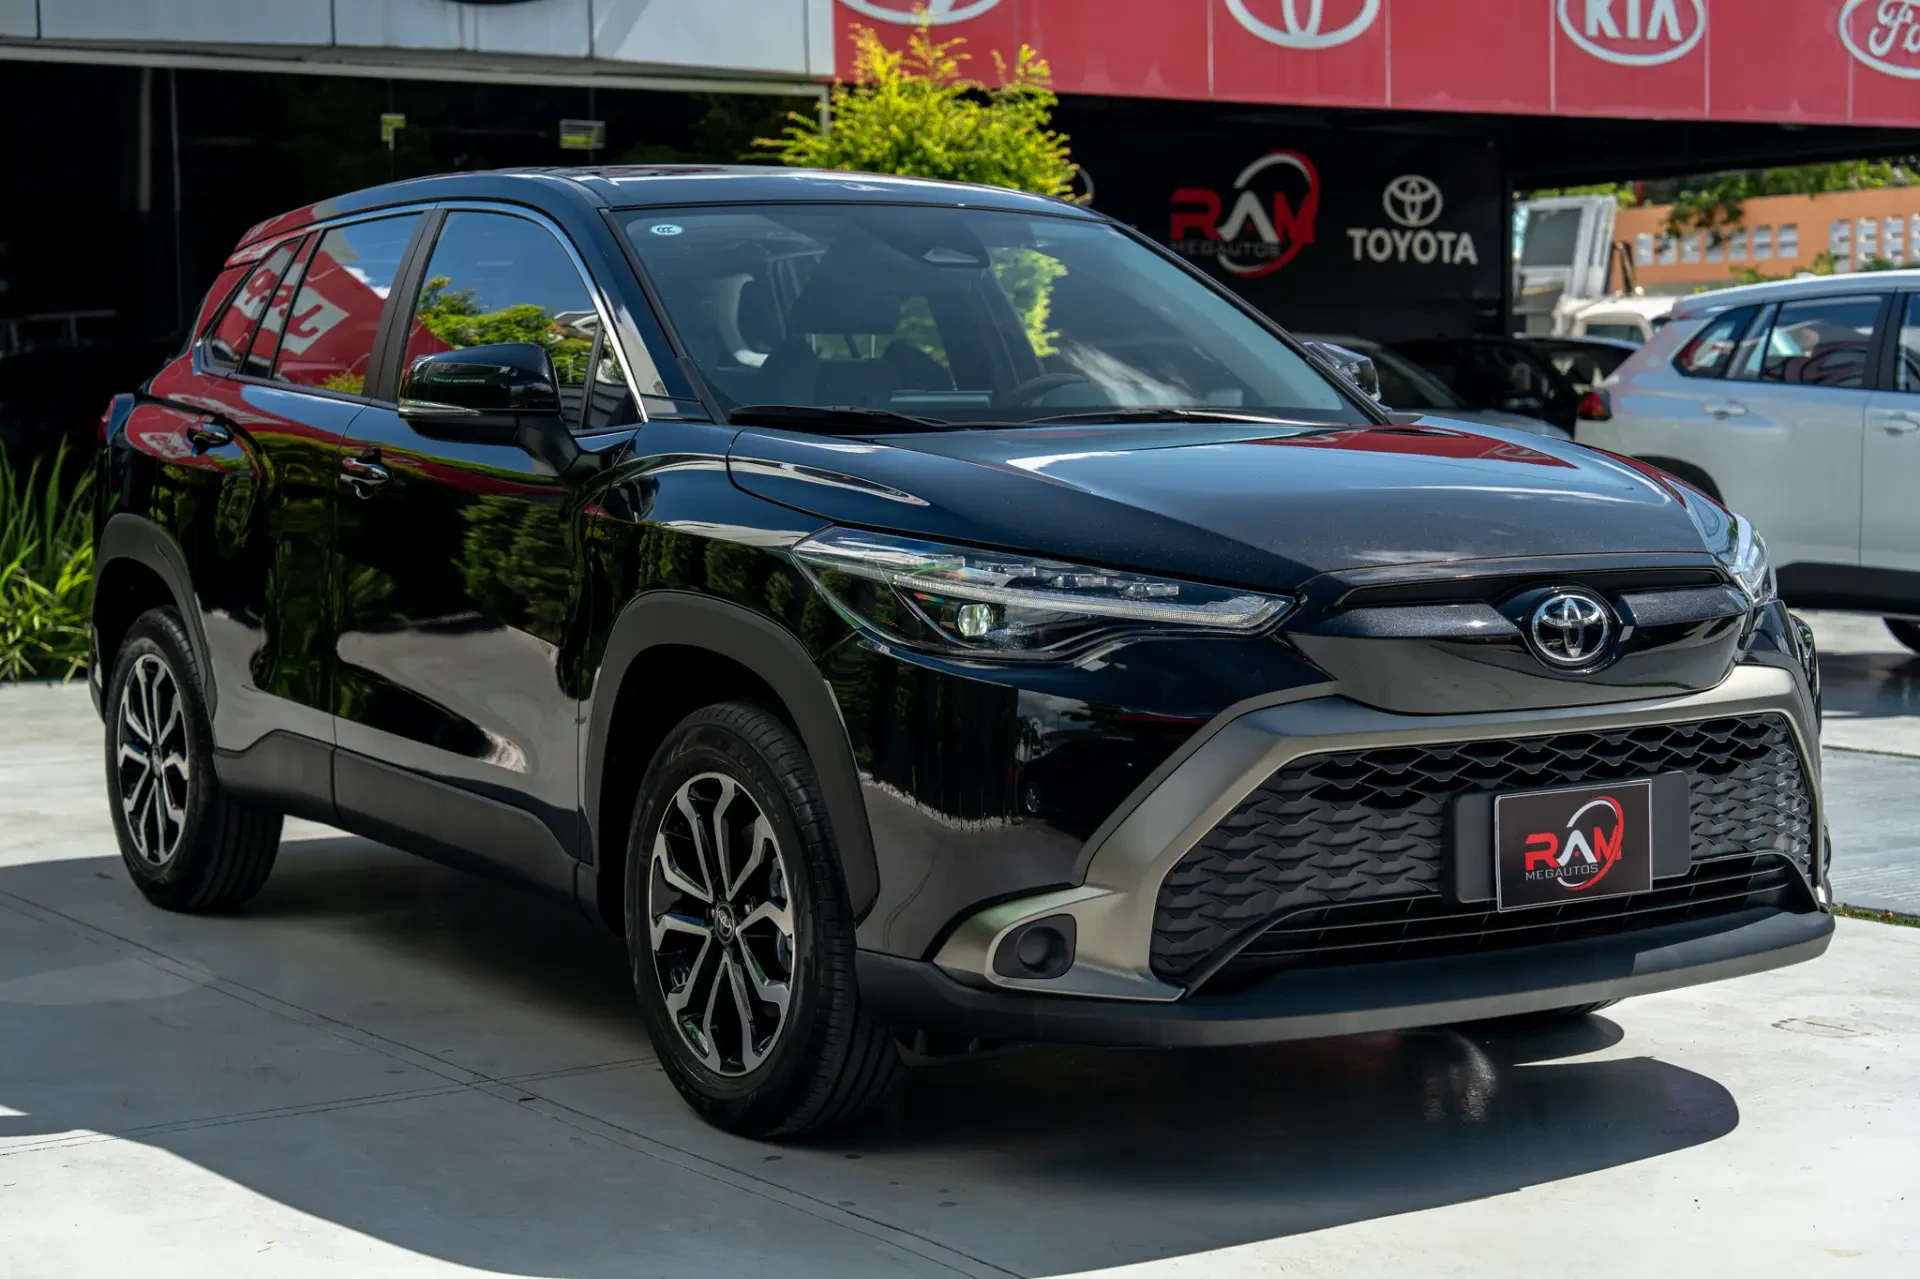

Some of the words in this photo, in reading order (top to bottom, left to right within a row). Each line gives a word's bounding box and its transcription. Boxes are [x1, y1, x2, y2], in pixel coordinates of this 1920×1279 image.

[1585, 0, 1683, 42] KIA
[1170, 187, 1315, 244] RAM
[1347, 227, 1478, 265] TOYOTA
[1524, 826, 1622, 871] RAM
[1525, 864, 1599, 881] MEGAUTOS
